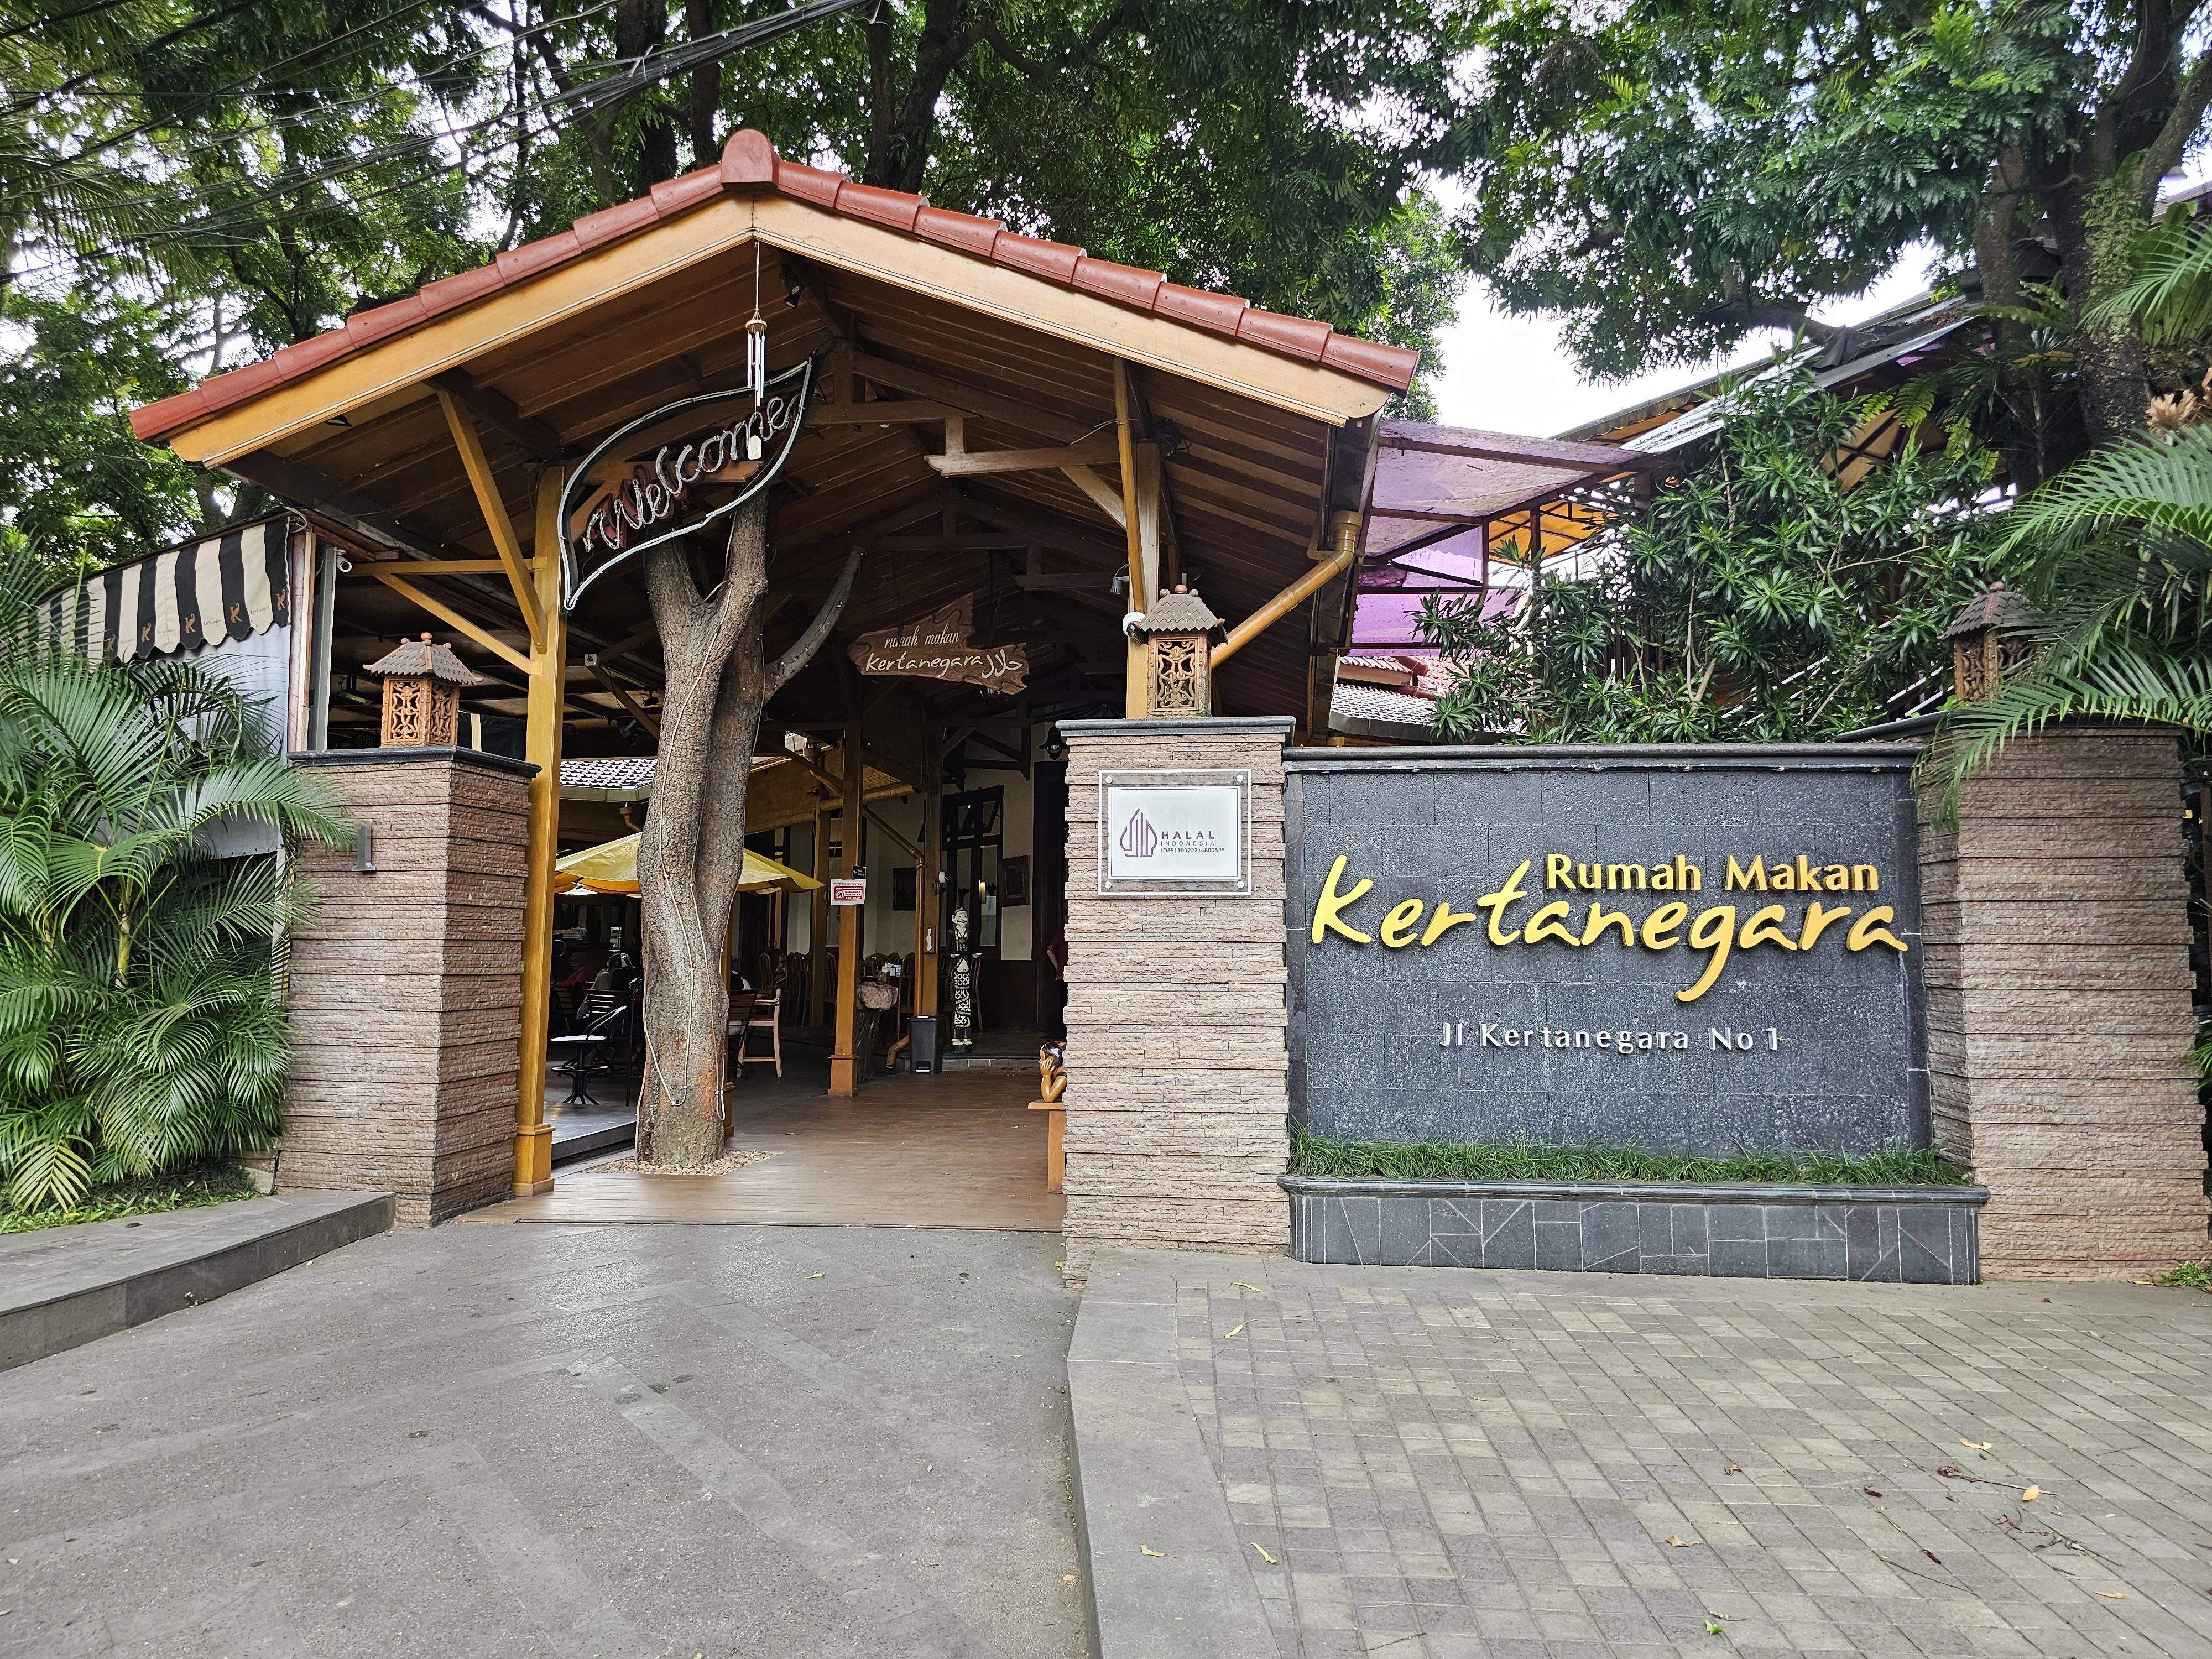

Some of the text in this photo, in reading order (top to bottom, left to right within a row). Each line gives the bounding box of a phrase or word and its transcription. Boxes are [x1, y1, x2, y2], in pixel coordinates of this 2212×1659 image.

[583, 393, 800, 552] Welcome
[925, 623, 960, 645] makan
[1161, 831, 1215, 839] HALAL
[1546, 853, 1879, 891] Rumah Makan
[1479, 1023, 1689, 1054] Kertanegara
[1709, 1026, 1754, 1051] No
[1766, 1027, 1778, 1051] 1
